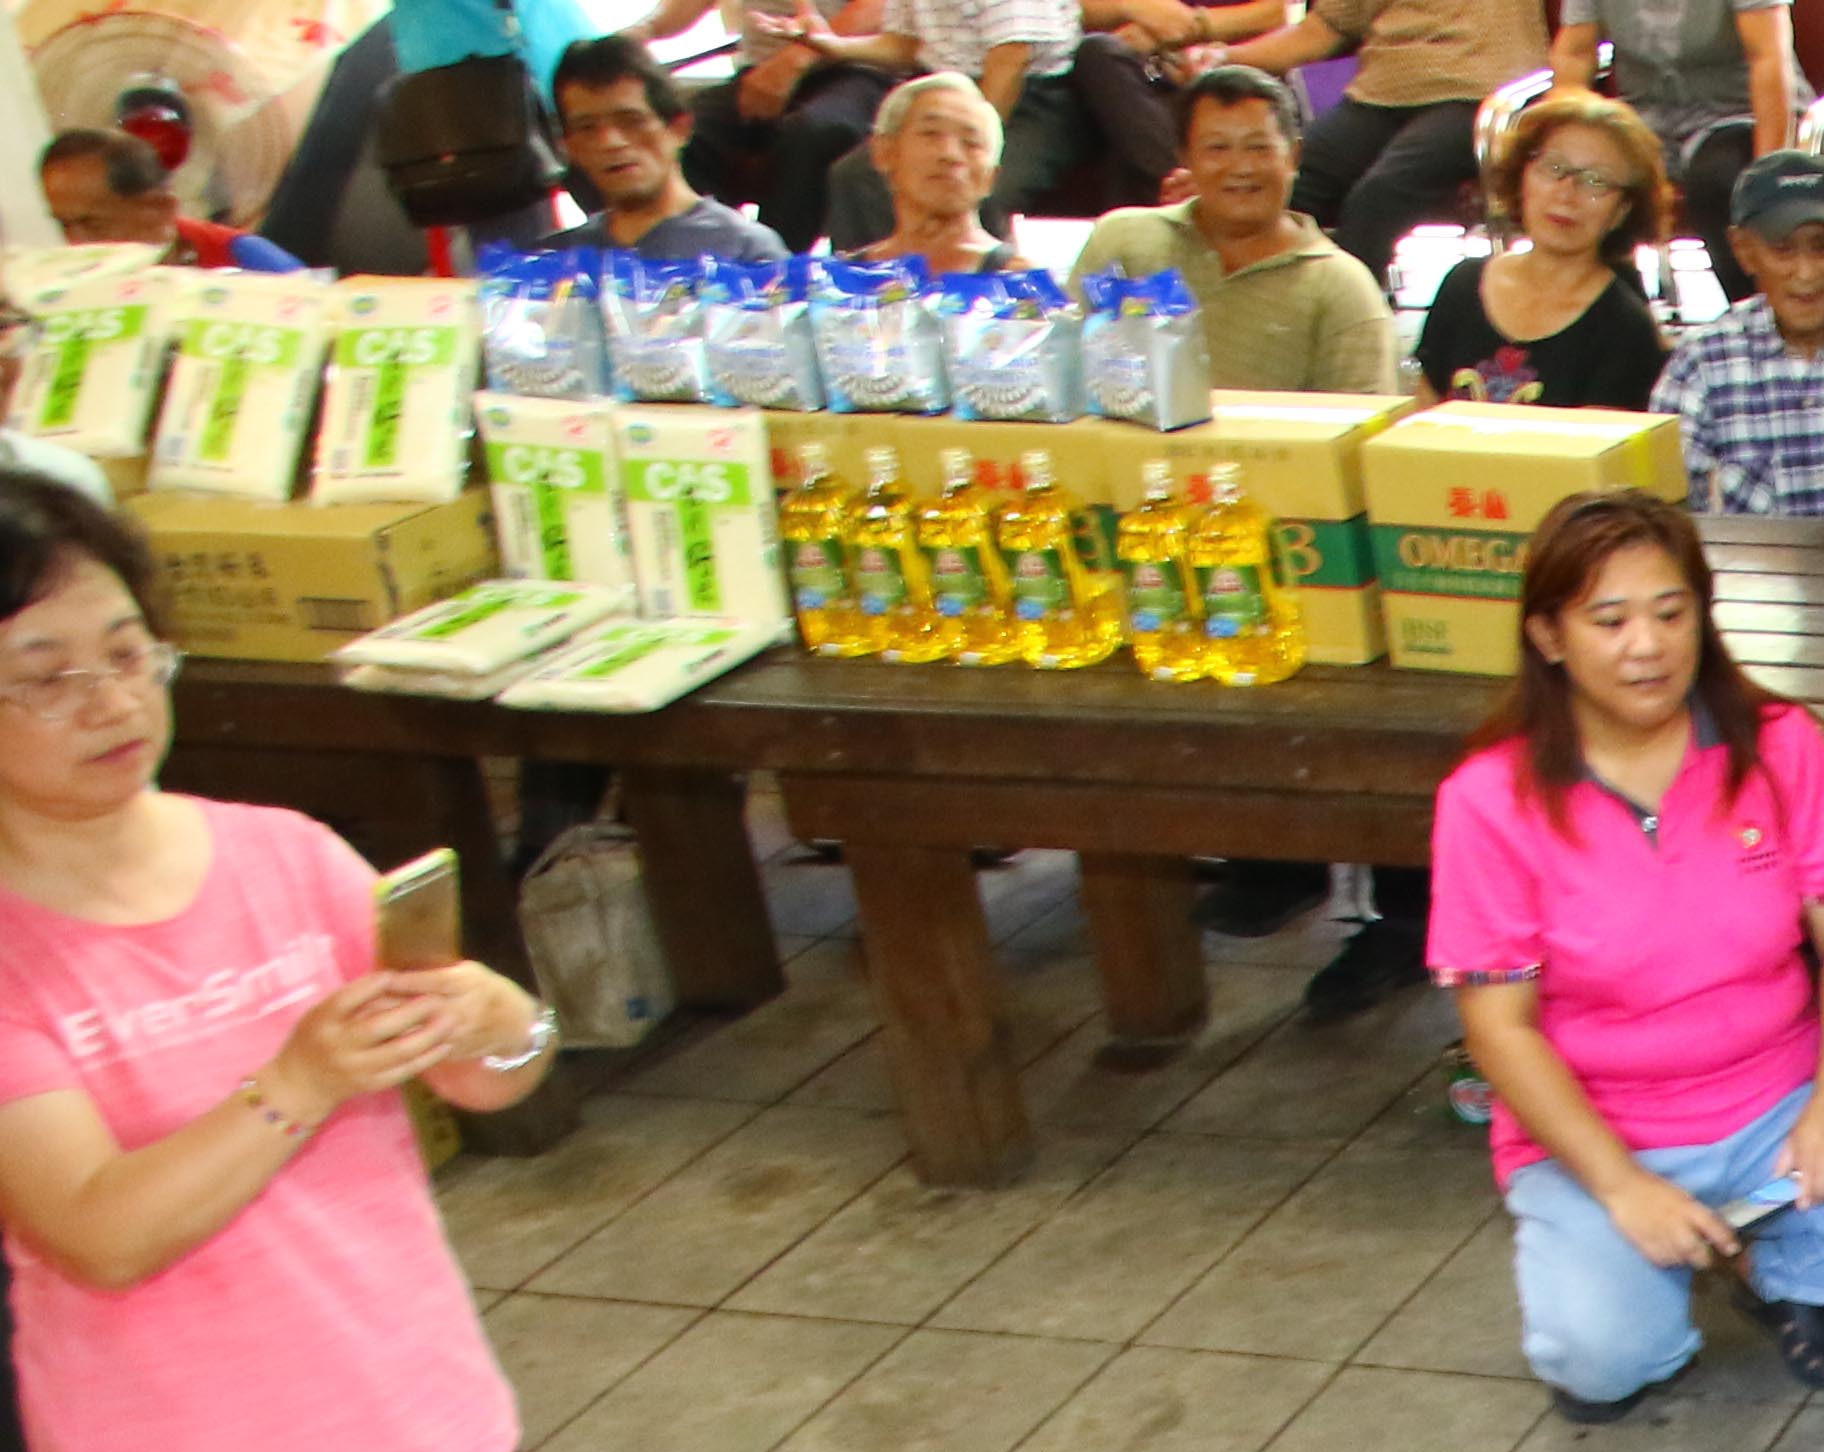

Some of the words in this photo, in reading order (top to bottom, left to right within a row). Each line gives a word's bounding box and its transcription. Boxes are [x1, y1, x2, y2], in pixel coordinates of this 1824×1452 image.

[201, 323, 283, 364] CAS
[354, 328, 437, 364] CAS
[504, 446, 587, 488] CAS
[644, 461, 732, 502] CAS
